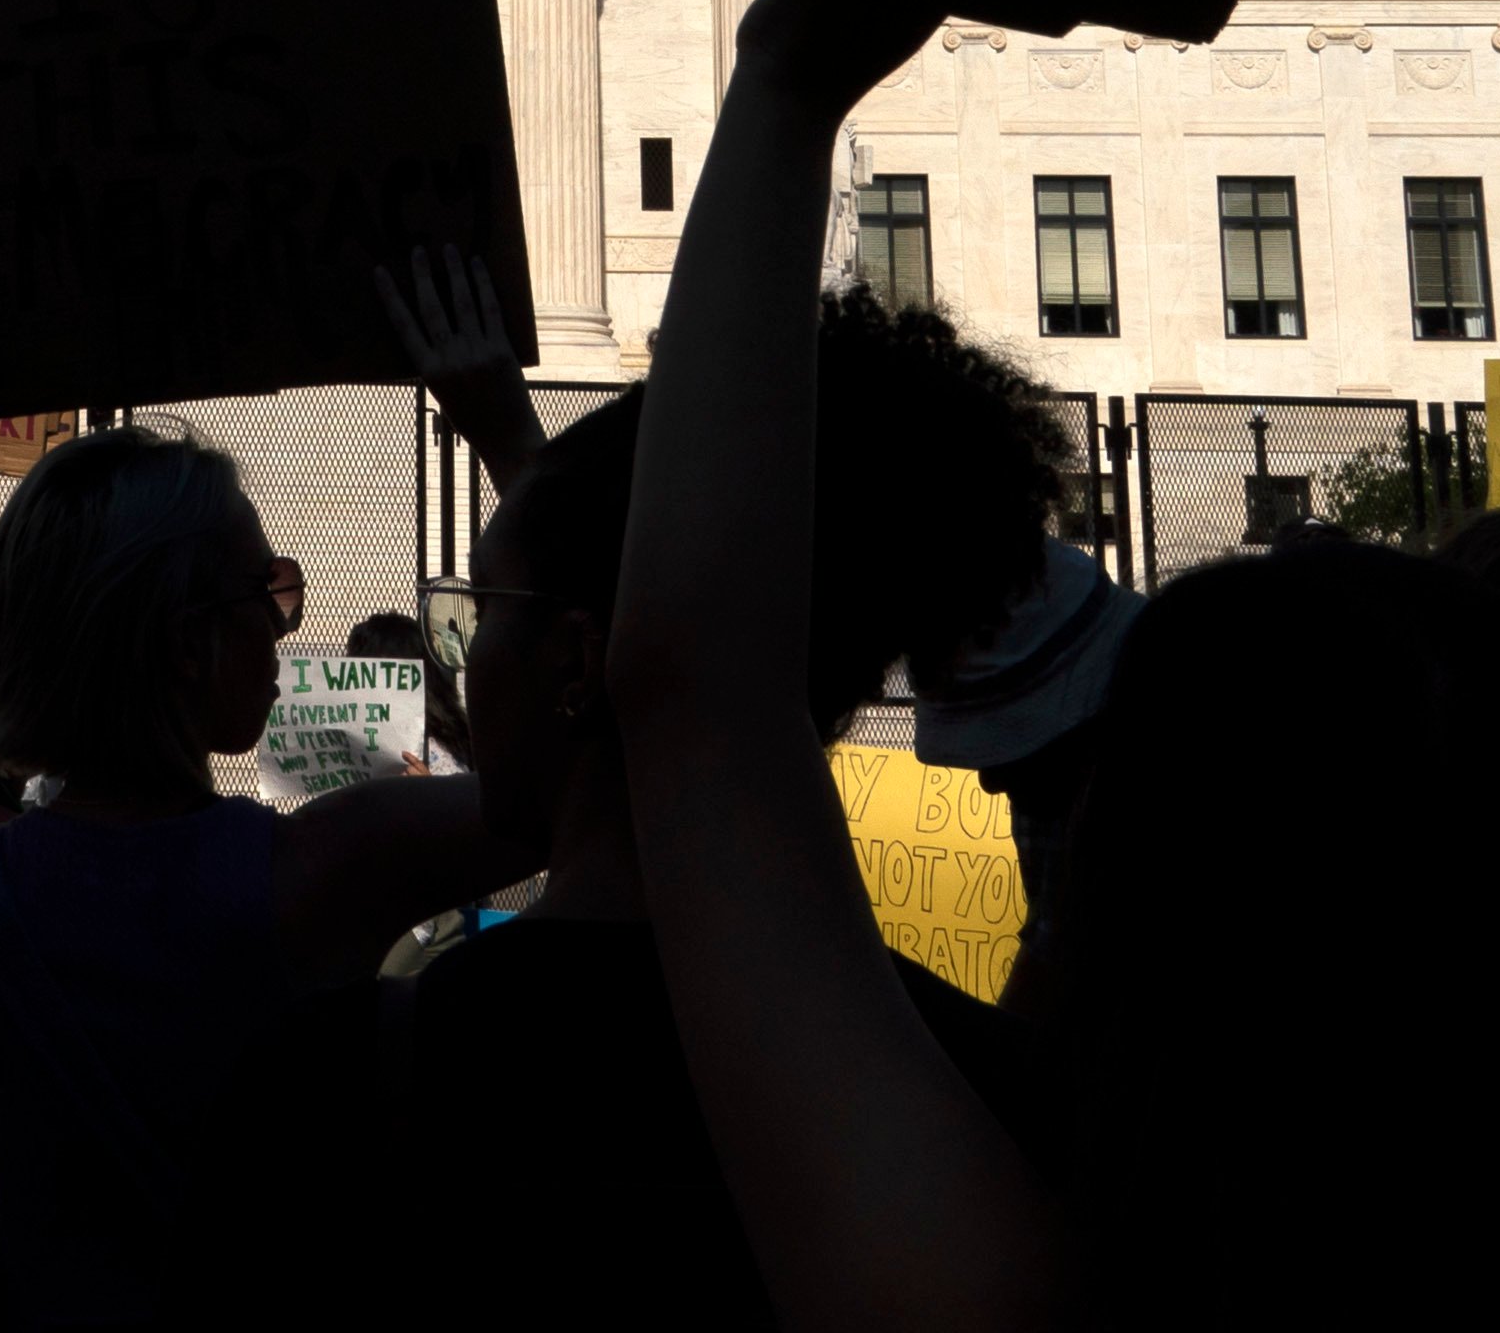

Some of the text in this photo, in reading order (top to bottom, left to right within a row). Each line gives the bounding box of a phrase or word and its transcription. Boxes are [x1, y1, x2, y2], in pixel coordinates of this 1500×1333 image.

[290, 658, 422, 694] I WANTED
[364, 702, 391, 724] IN
[363, 727, 380, 752] I
